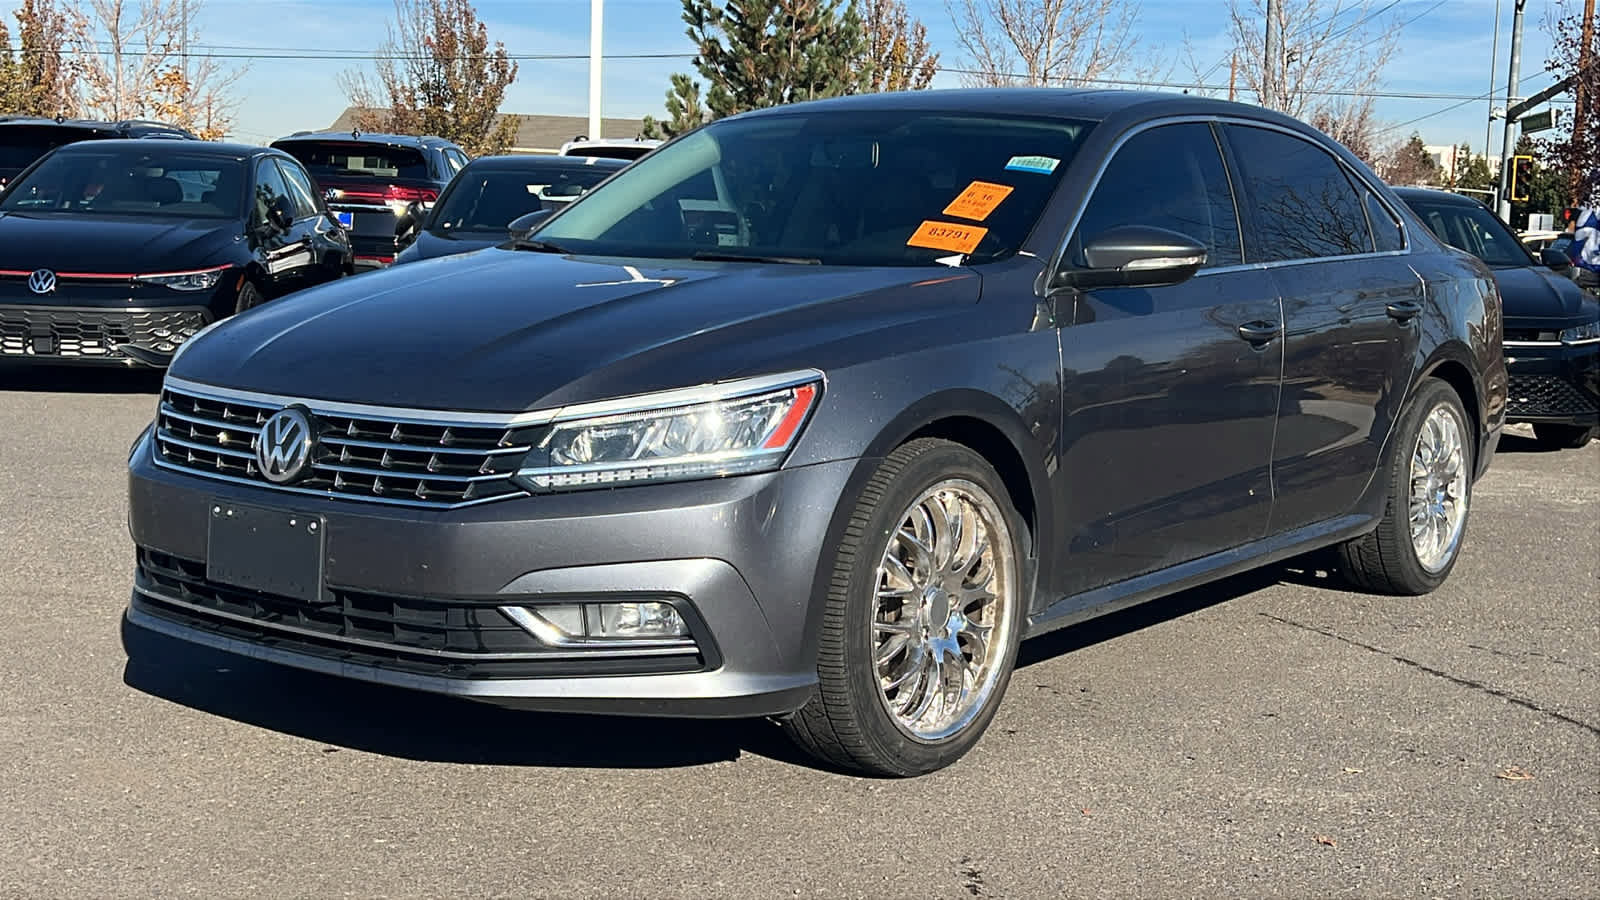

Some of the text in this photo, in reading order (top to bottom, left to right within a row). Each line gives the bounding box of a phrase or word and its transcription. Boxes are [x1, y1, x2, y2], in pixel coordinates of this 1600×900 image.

[928, 228, 970, 240] 83791
[29, 269, 56, 293] VW
[258, 410, 309, 481] VW
